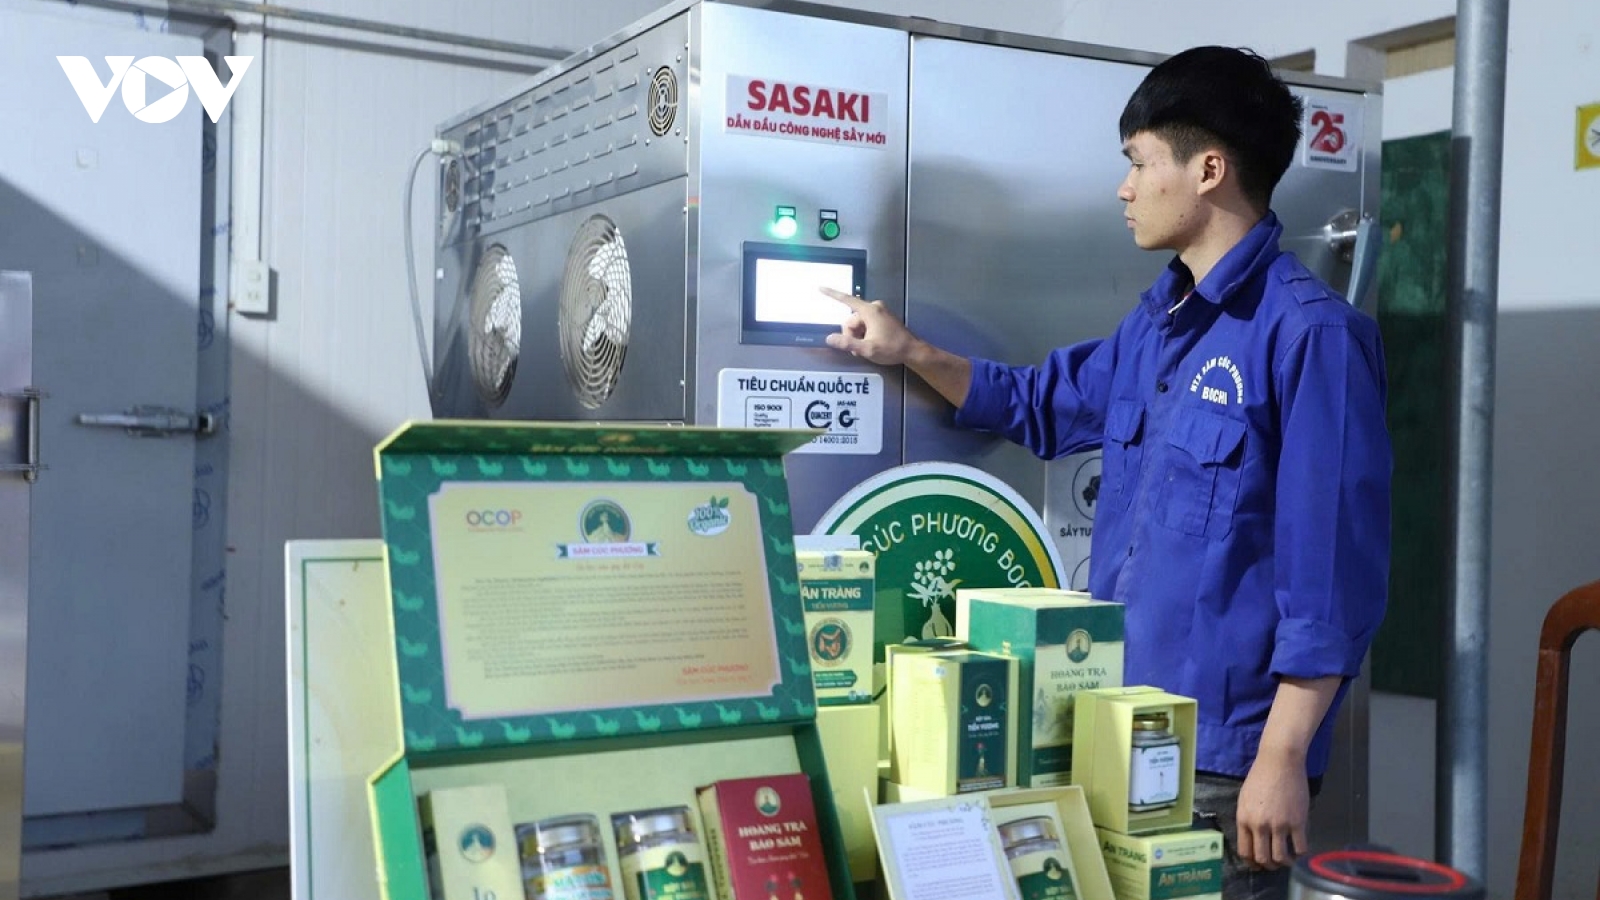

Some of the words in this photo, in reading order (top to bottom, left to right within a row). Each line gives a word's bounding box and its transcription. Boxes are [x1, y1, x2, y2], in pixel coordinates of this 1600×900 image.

[747, 79, 870, 124] SASAKI
[779, 121, 810, 137] CÔNG
[811, 126, 841, 142] NGHỆ
[1310, 111, 1345, 154] 25
[737, 376, 767, 392] TIÊU
[854, 376, 871, 395] TẾ
[466, 509, 523, 527] OCOP
[911, 511, 1000, 553] PHƯƠNG
